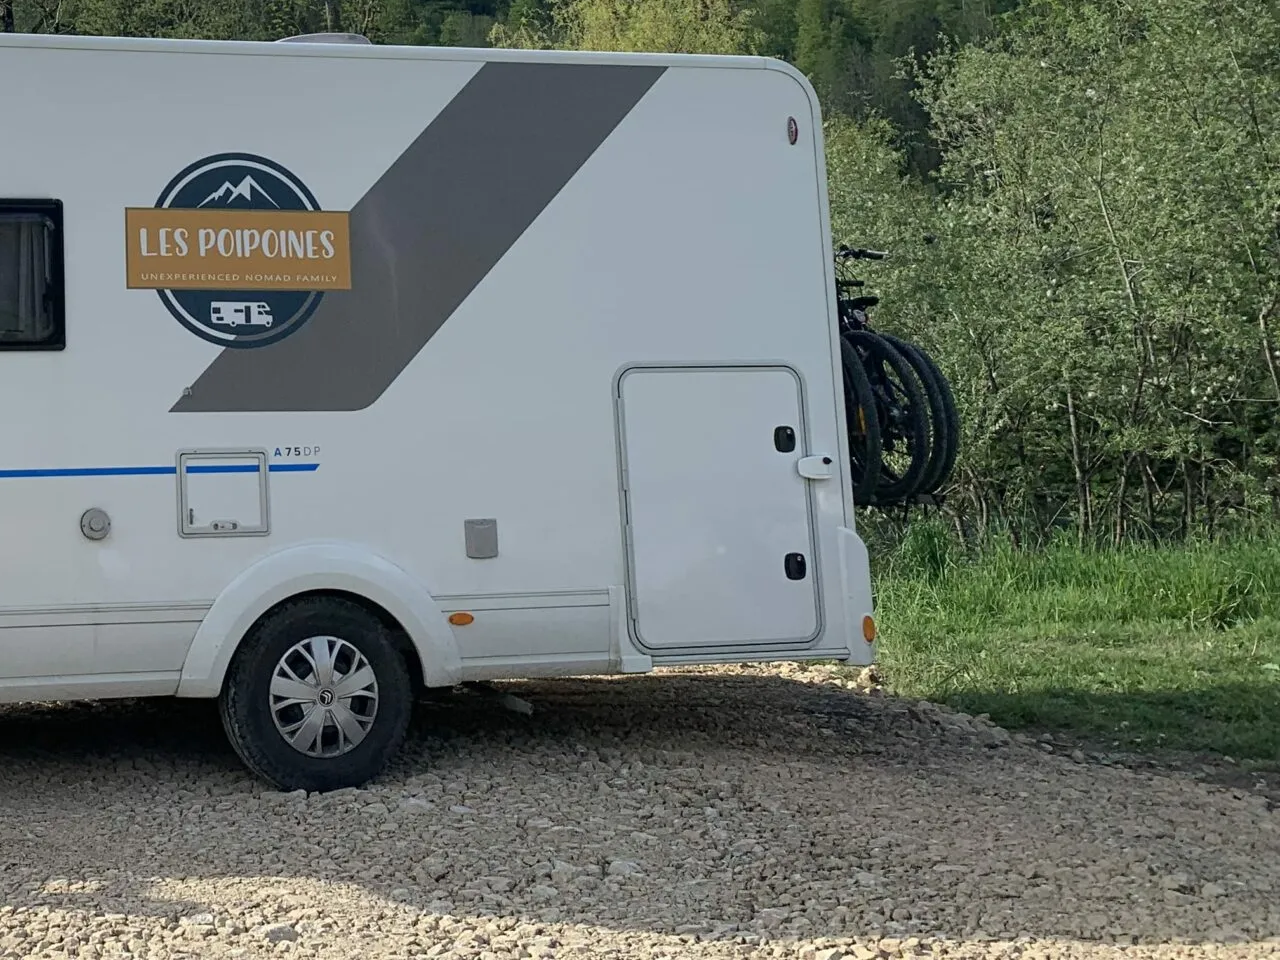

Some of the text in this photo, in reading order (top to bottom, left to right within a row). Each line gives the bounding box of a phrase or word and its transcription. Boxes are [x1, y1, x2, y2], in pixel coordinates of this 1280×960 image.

[139, 227, 336, 259] LES POIPOINES
[140, 272, 338, 283] UNEXPERIENCED NOMAD FAMILY
